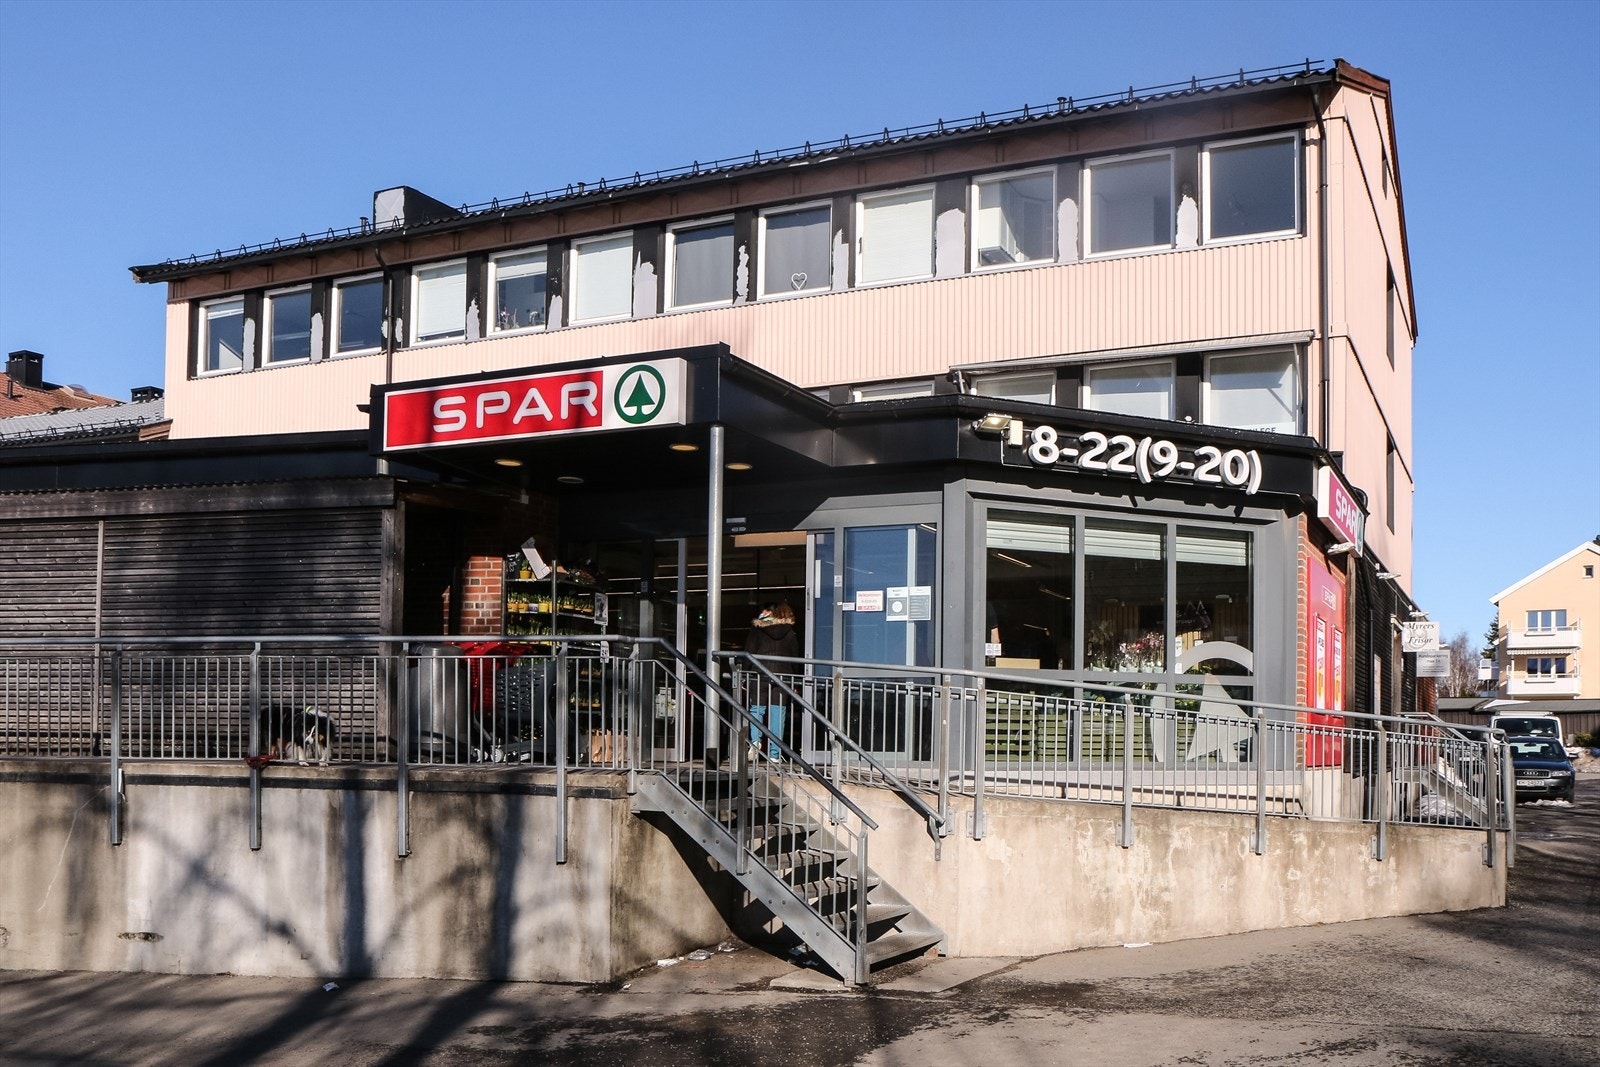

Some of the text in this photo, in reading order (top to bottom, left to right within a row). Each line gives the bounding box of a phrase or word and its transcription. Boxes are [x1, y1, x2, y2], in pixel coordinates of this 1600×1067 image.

[433, 380, 598, 433] SPAR
[1028, 425, 1263, 496] 8-22(9-20)
[1335, 488, 1359, 535] SPAR
